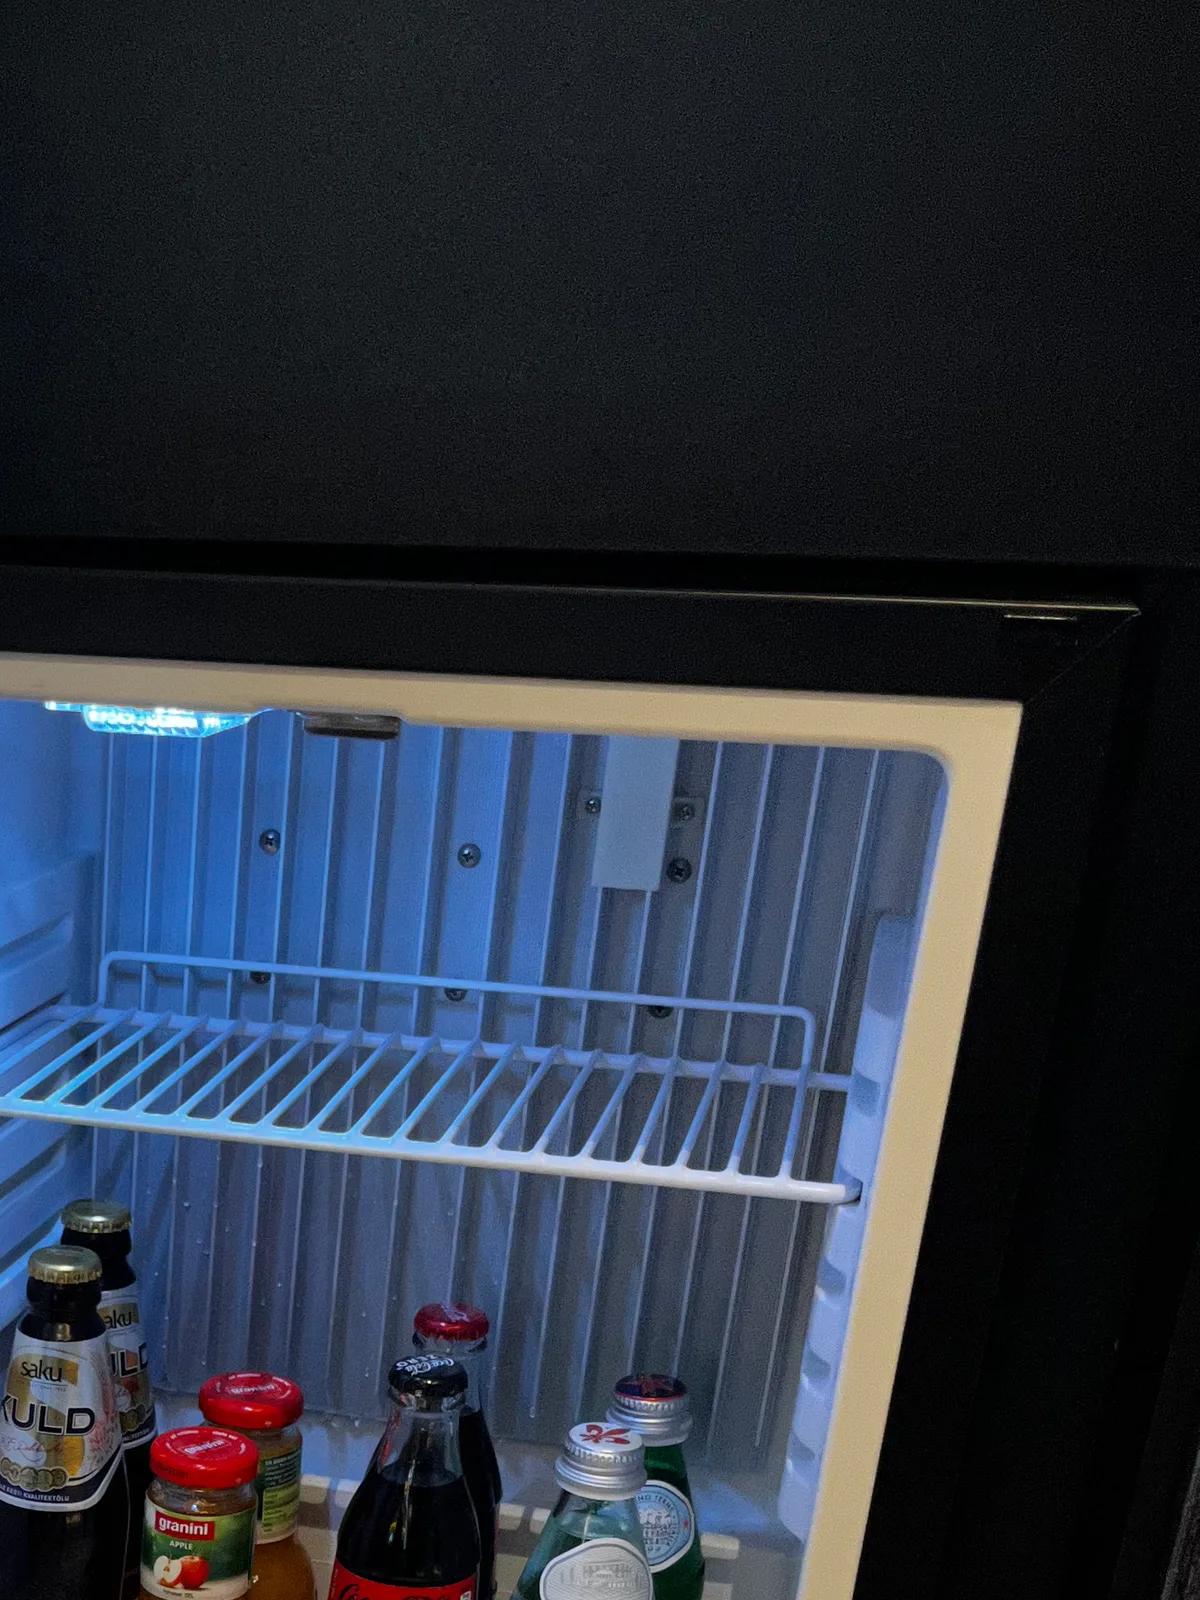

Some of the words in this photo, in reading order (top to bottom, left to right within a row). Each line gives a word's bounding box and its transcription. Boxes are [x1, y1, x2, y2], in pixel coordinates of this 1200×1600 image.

[104, 1309, 132, 1328] aku
[111, 1342, 148, 1377] LD
[20, 1360, 63, 1382] saku
[1, 1395, 96, 1435] KULD
[159, 1517, 208, 1536] granini
[169, 1540, 193, 1550] APPLE
